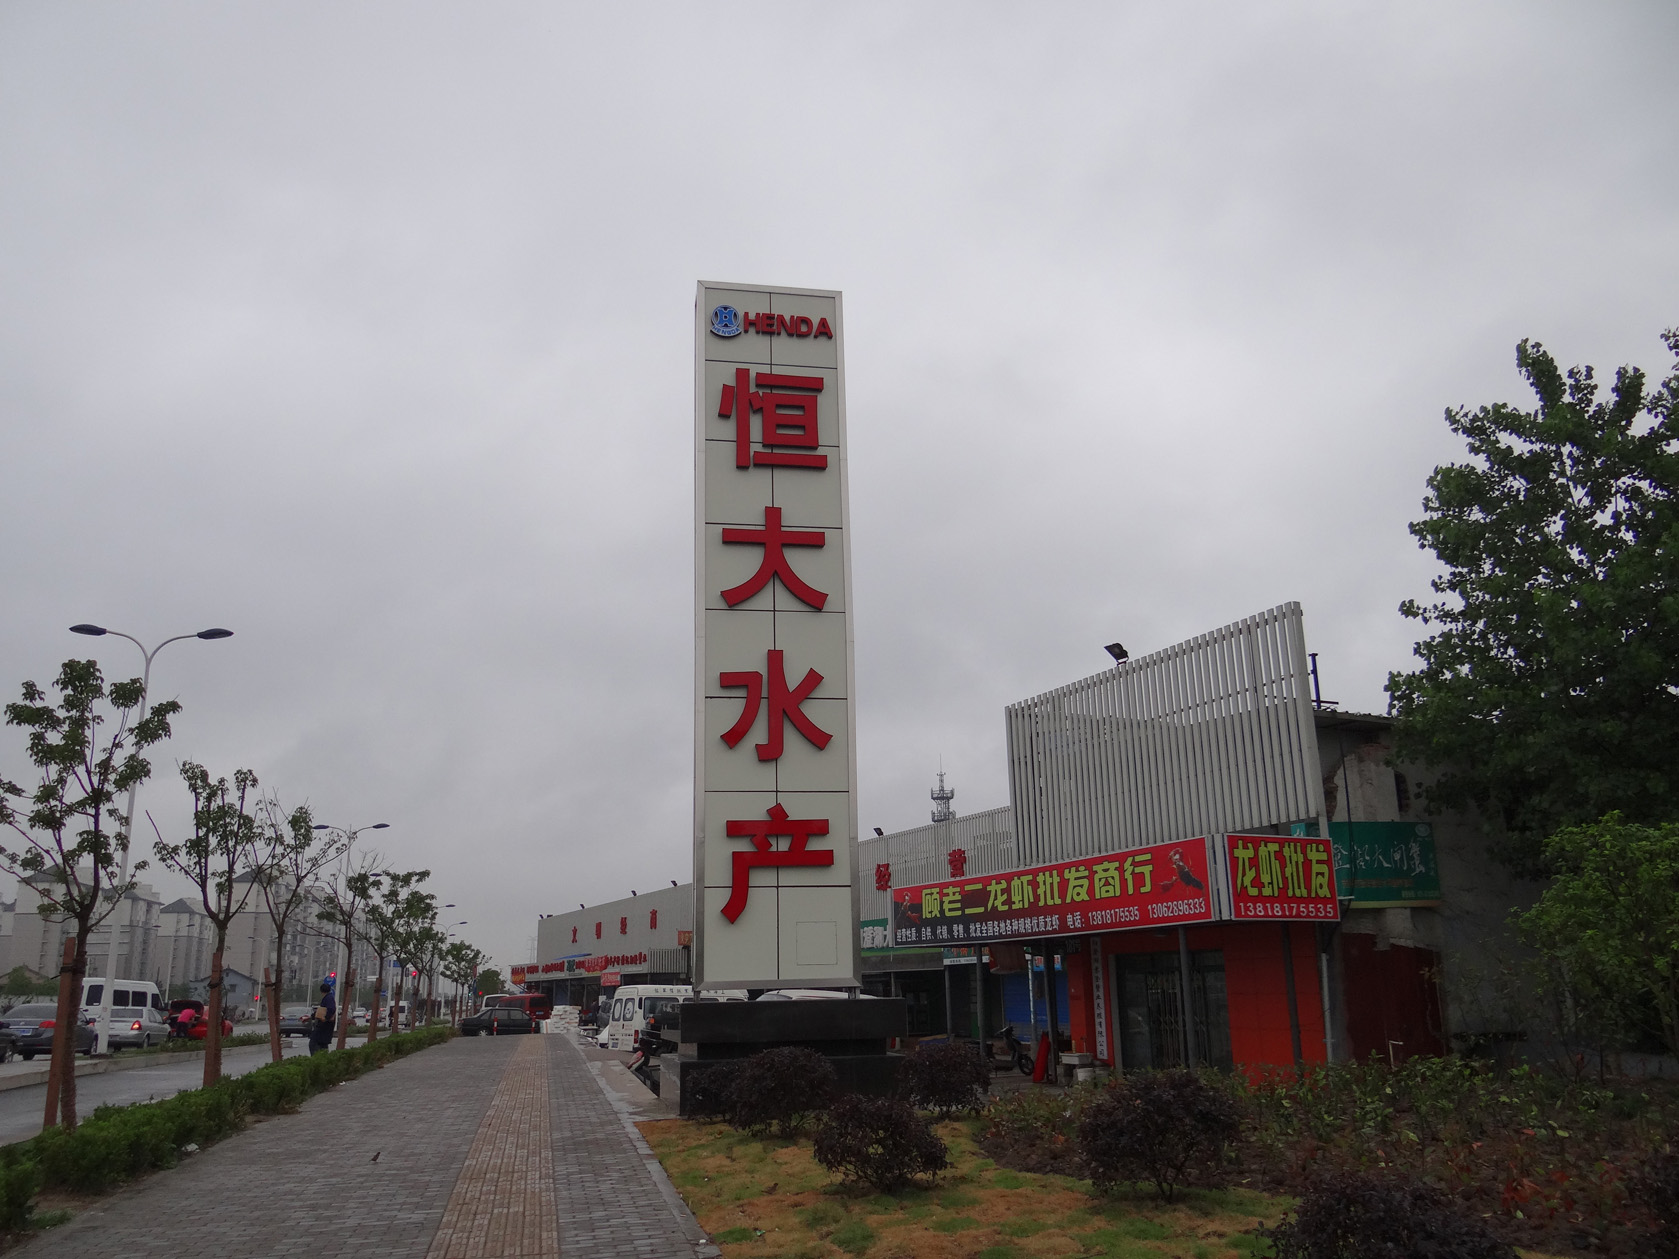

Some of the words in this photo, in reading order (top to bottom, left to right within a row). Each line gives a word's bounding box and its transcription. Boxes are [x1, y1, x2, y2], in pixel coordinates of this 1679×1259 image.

[743, 311, 833, 339] HENDA
[718, 367, 834, 925] 恒大水产
[922, 853, 1153, 919] 顾老二龙虾批发商行
[1233, 839, 1332, 898] 龙虾批发
[1088, 906, 1140, 926] 13818175535
[1147, 898, 1206, 919] 13062896333
[1239, 902, 1334, 917] 13818175535
